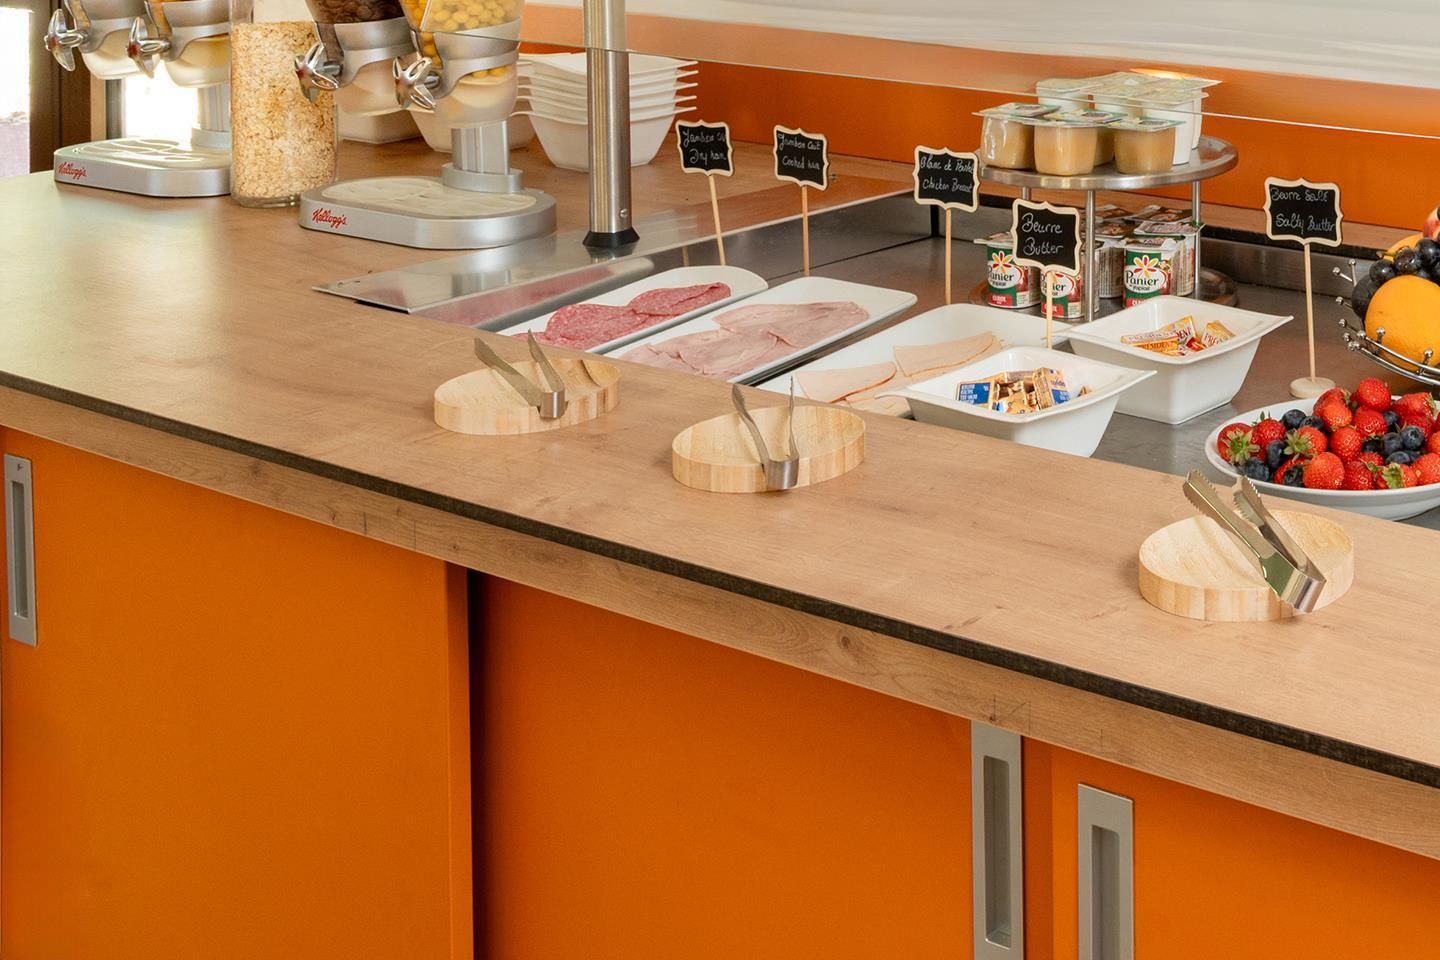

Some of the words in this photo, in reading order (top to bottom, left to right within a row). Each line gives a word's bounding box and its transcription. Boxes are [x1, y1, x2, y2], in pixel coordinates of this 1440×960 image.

[58, 161, 87, 180] Kellogg's
[312, 208, 347, 229] Kellogg's
[1021, 212, 1063, 234] Beurre
[1275, 212, 1304, 235] Salty
[1022, 236, 1064, 256] Butter
[1125, 270, 1159, 286] Panier
